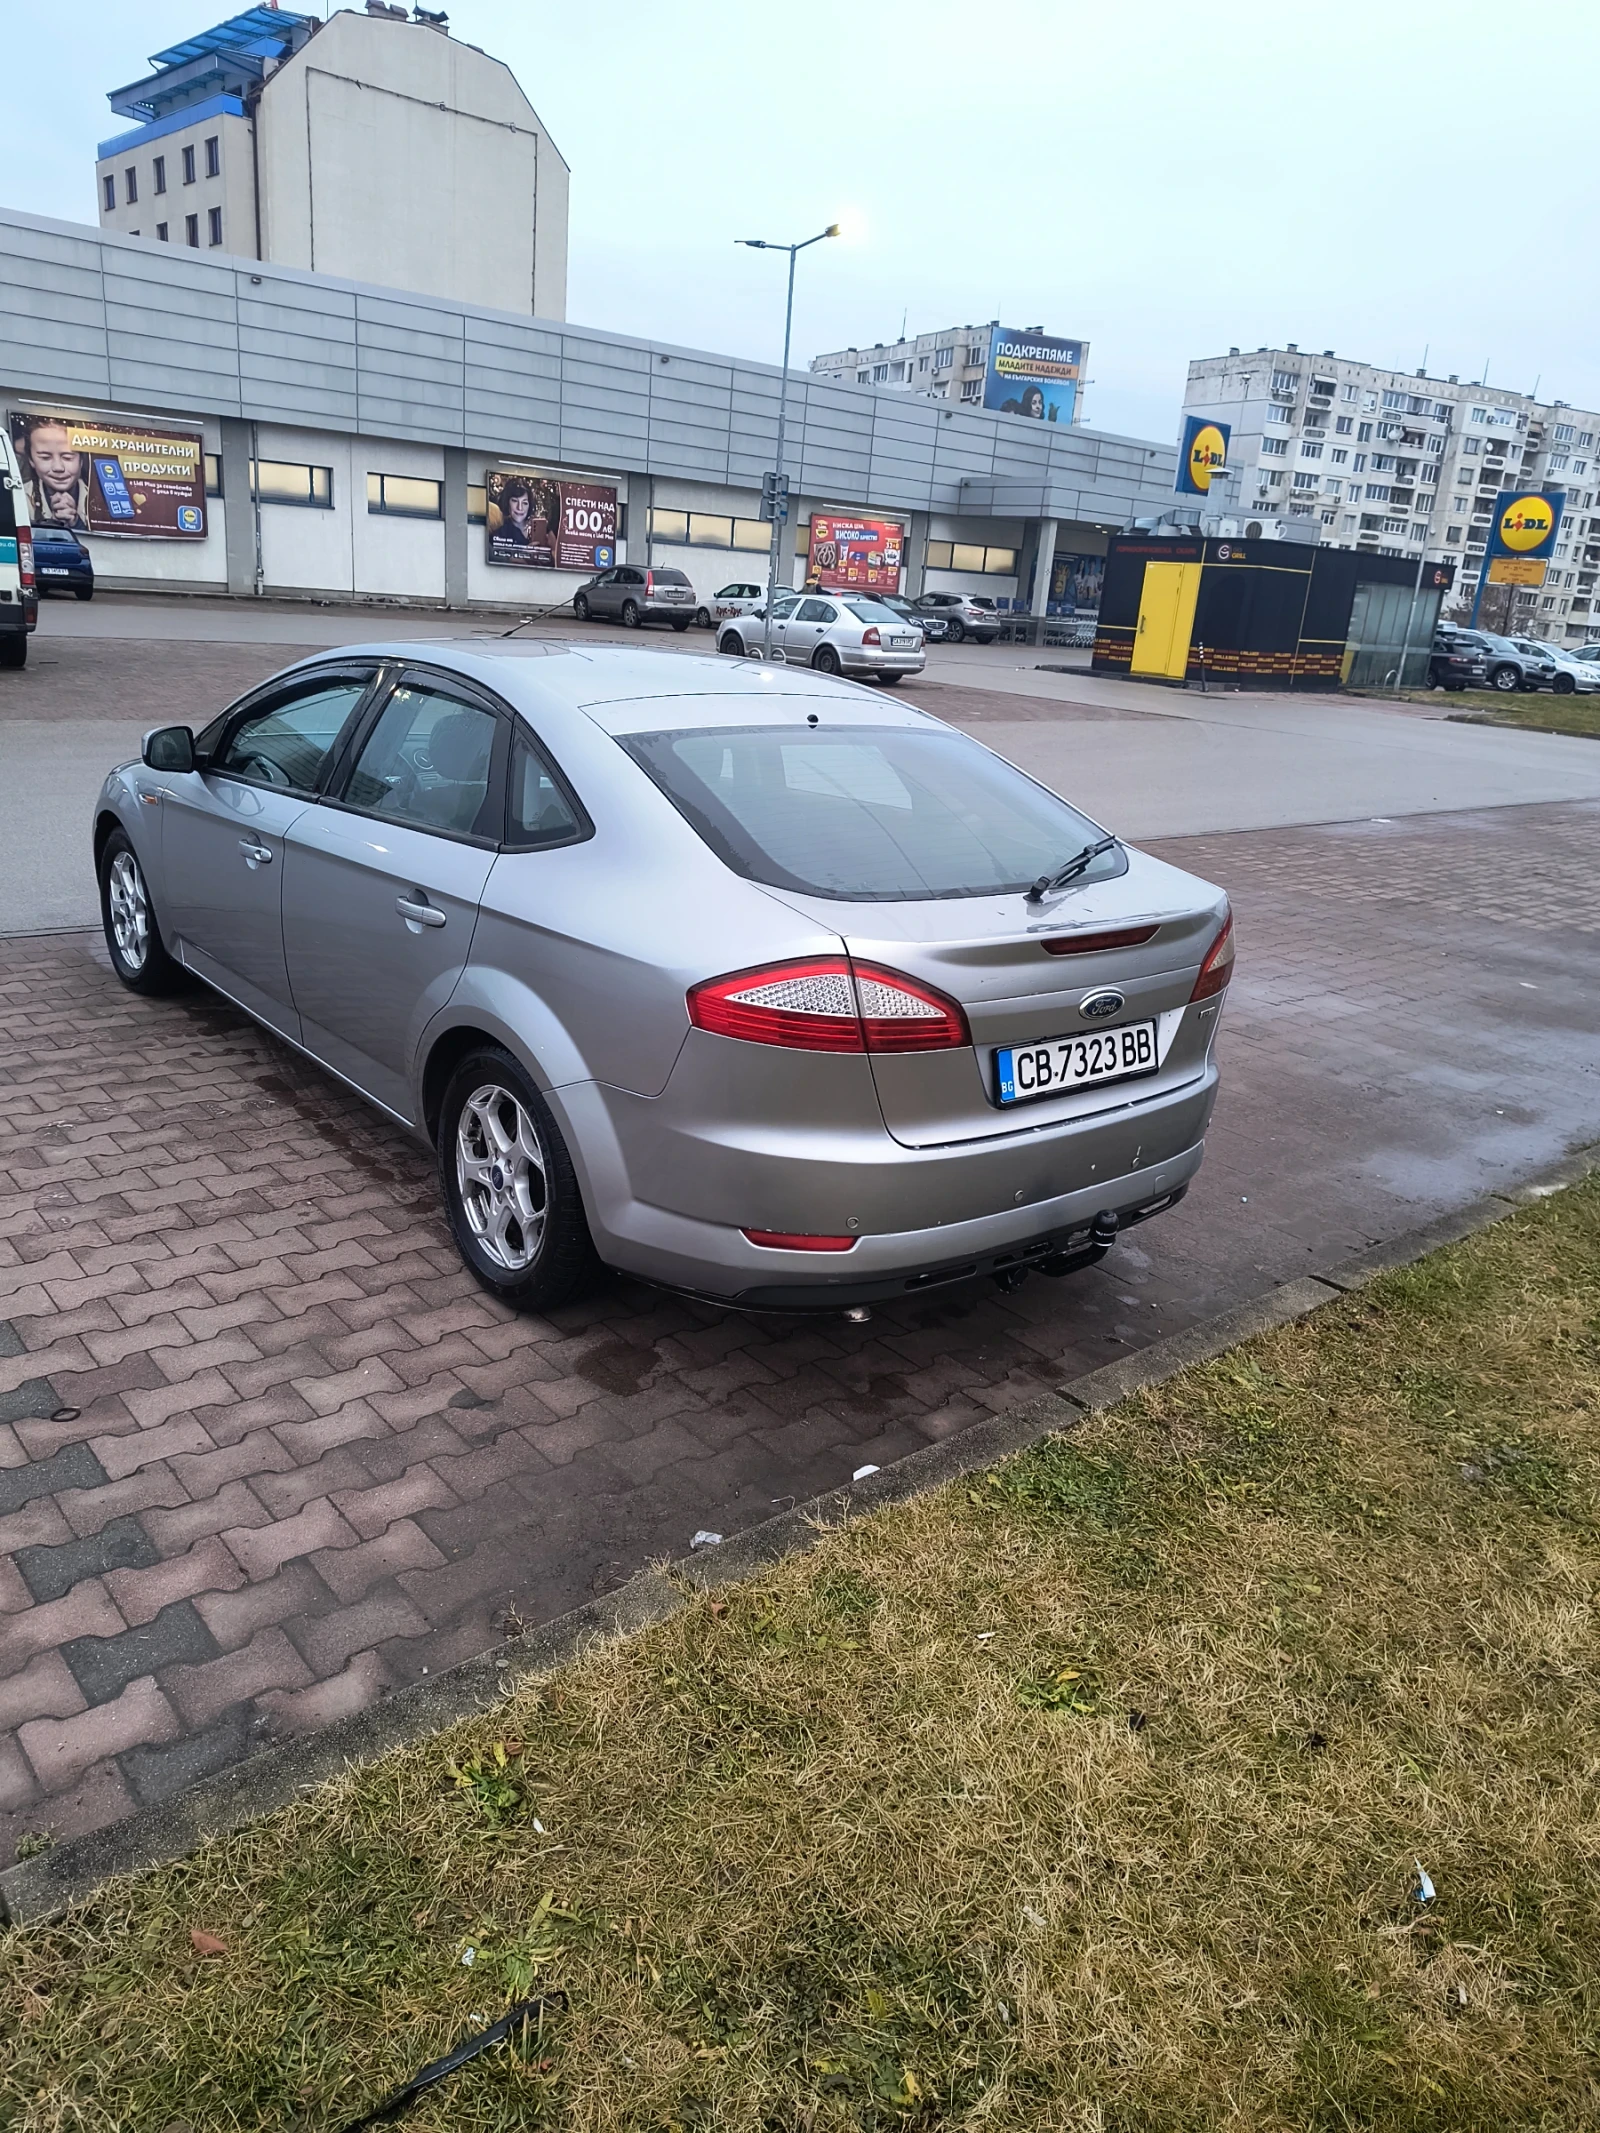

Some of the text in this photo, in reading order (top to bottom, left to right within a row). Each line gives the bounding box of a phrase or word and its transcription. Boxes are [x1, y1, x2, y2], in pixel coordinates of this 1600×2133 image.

[996, 342, 1073, 362] ПОДКРЕПЯМЕ
[998, 359, 1071, 376] МЛАДИТЕ НАДЕЖДИ
[72, 434, 194, 458] ДАРИ ХРАНИТЕЛНИ
[123, 462, 191, 476] ПРОДУКТИ
[566, 497, 615, 512] СПЕСТИ НАД
[835, 530, 859, 540] ВИСОКО
[1091, 997, 1118, 1015] Ford
[1001, 1080, 1014, 1093] BG
